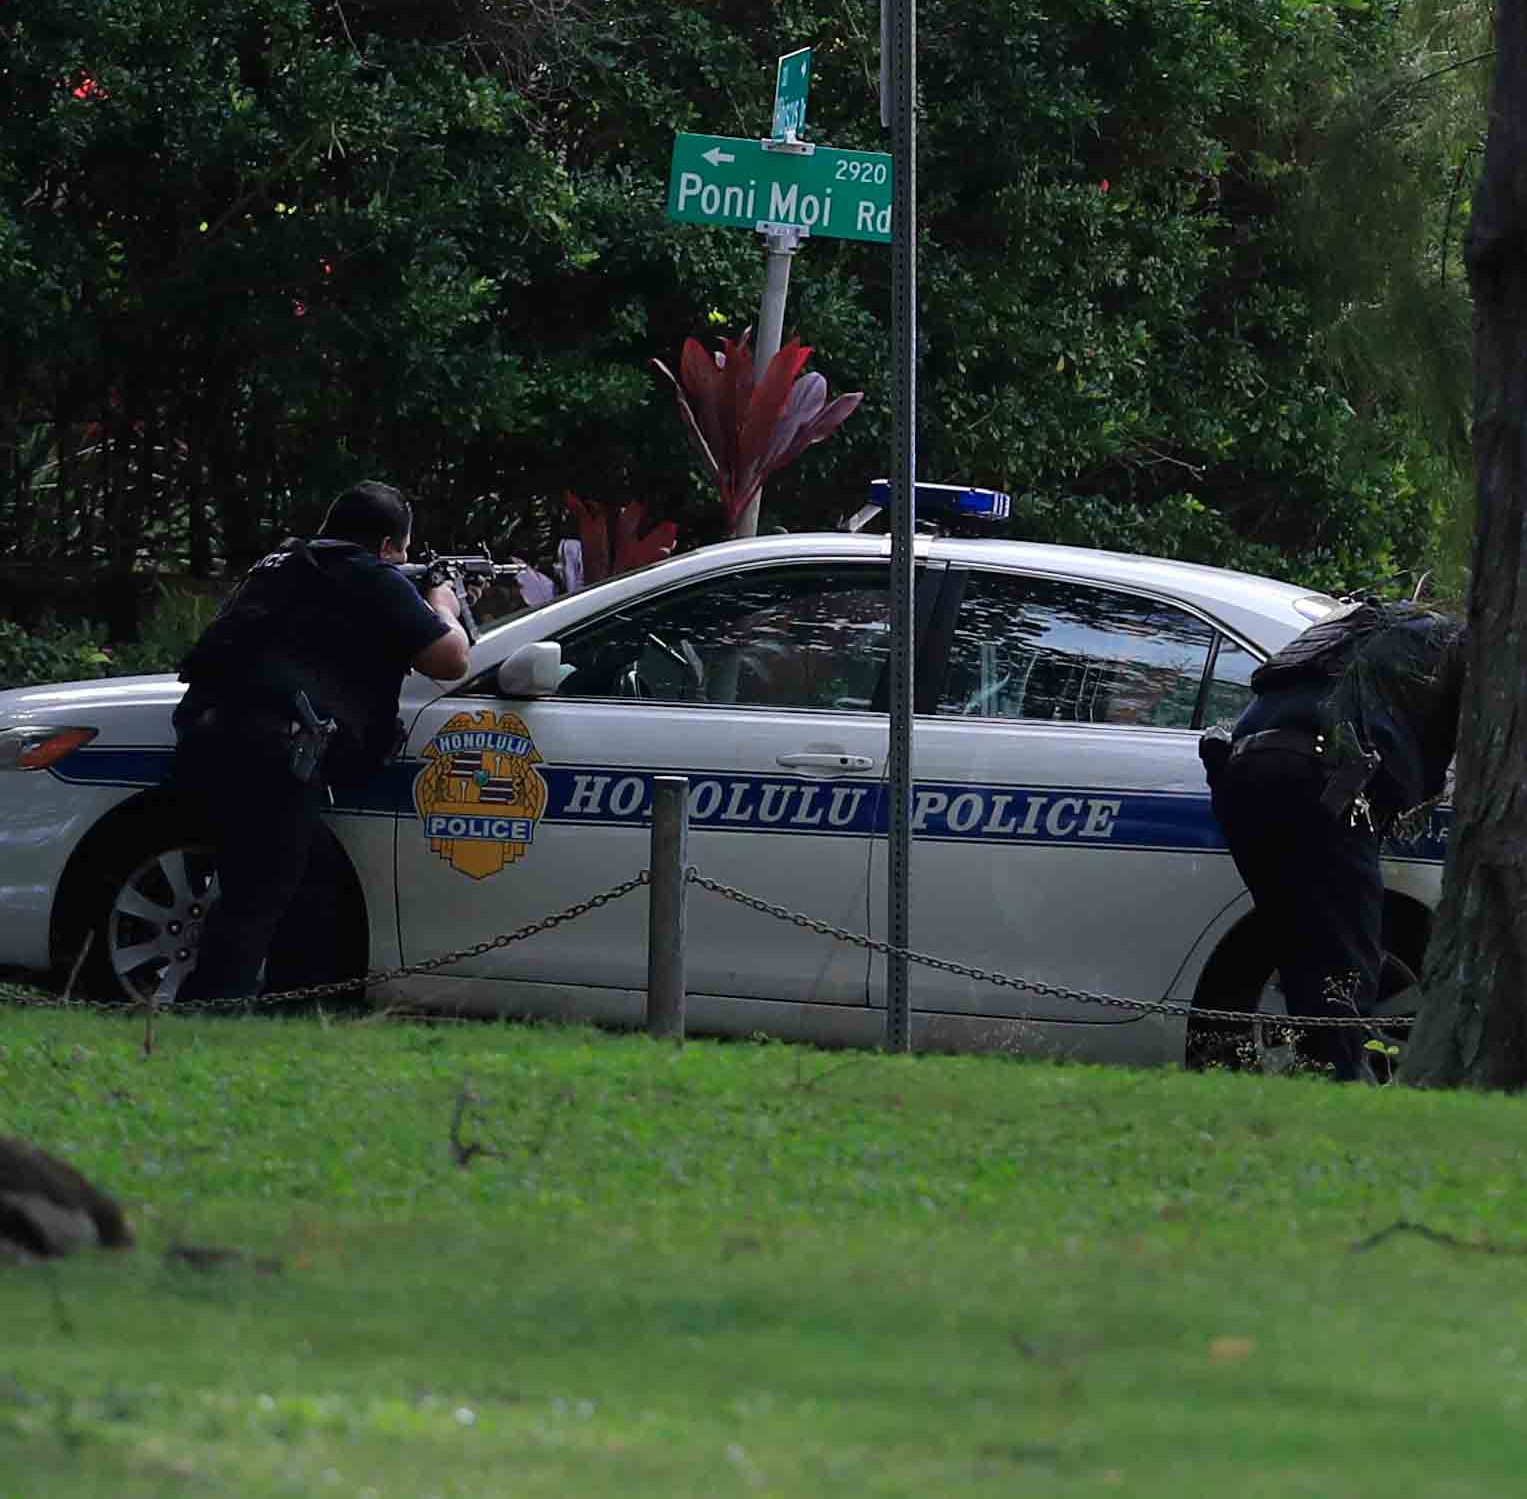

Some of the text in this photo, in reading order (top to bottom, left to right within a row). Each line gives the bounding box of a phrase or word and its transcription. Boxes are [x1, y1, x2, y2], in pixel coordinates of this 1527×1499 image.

[835, 159, 887, 185] 2920
[677, 172, 892, 234] Poni Moi Rd
[439, 732, 529, 756] HONOLULU
[563, 774, 867, 826] HOOLULU
[912, 791, 1122, 838] POLICE
[430, 817, 528, 840] POLICE
